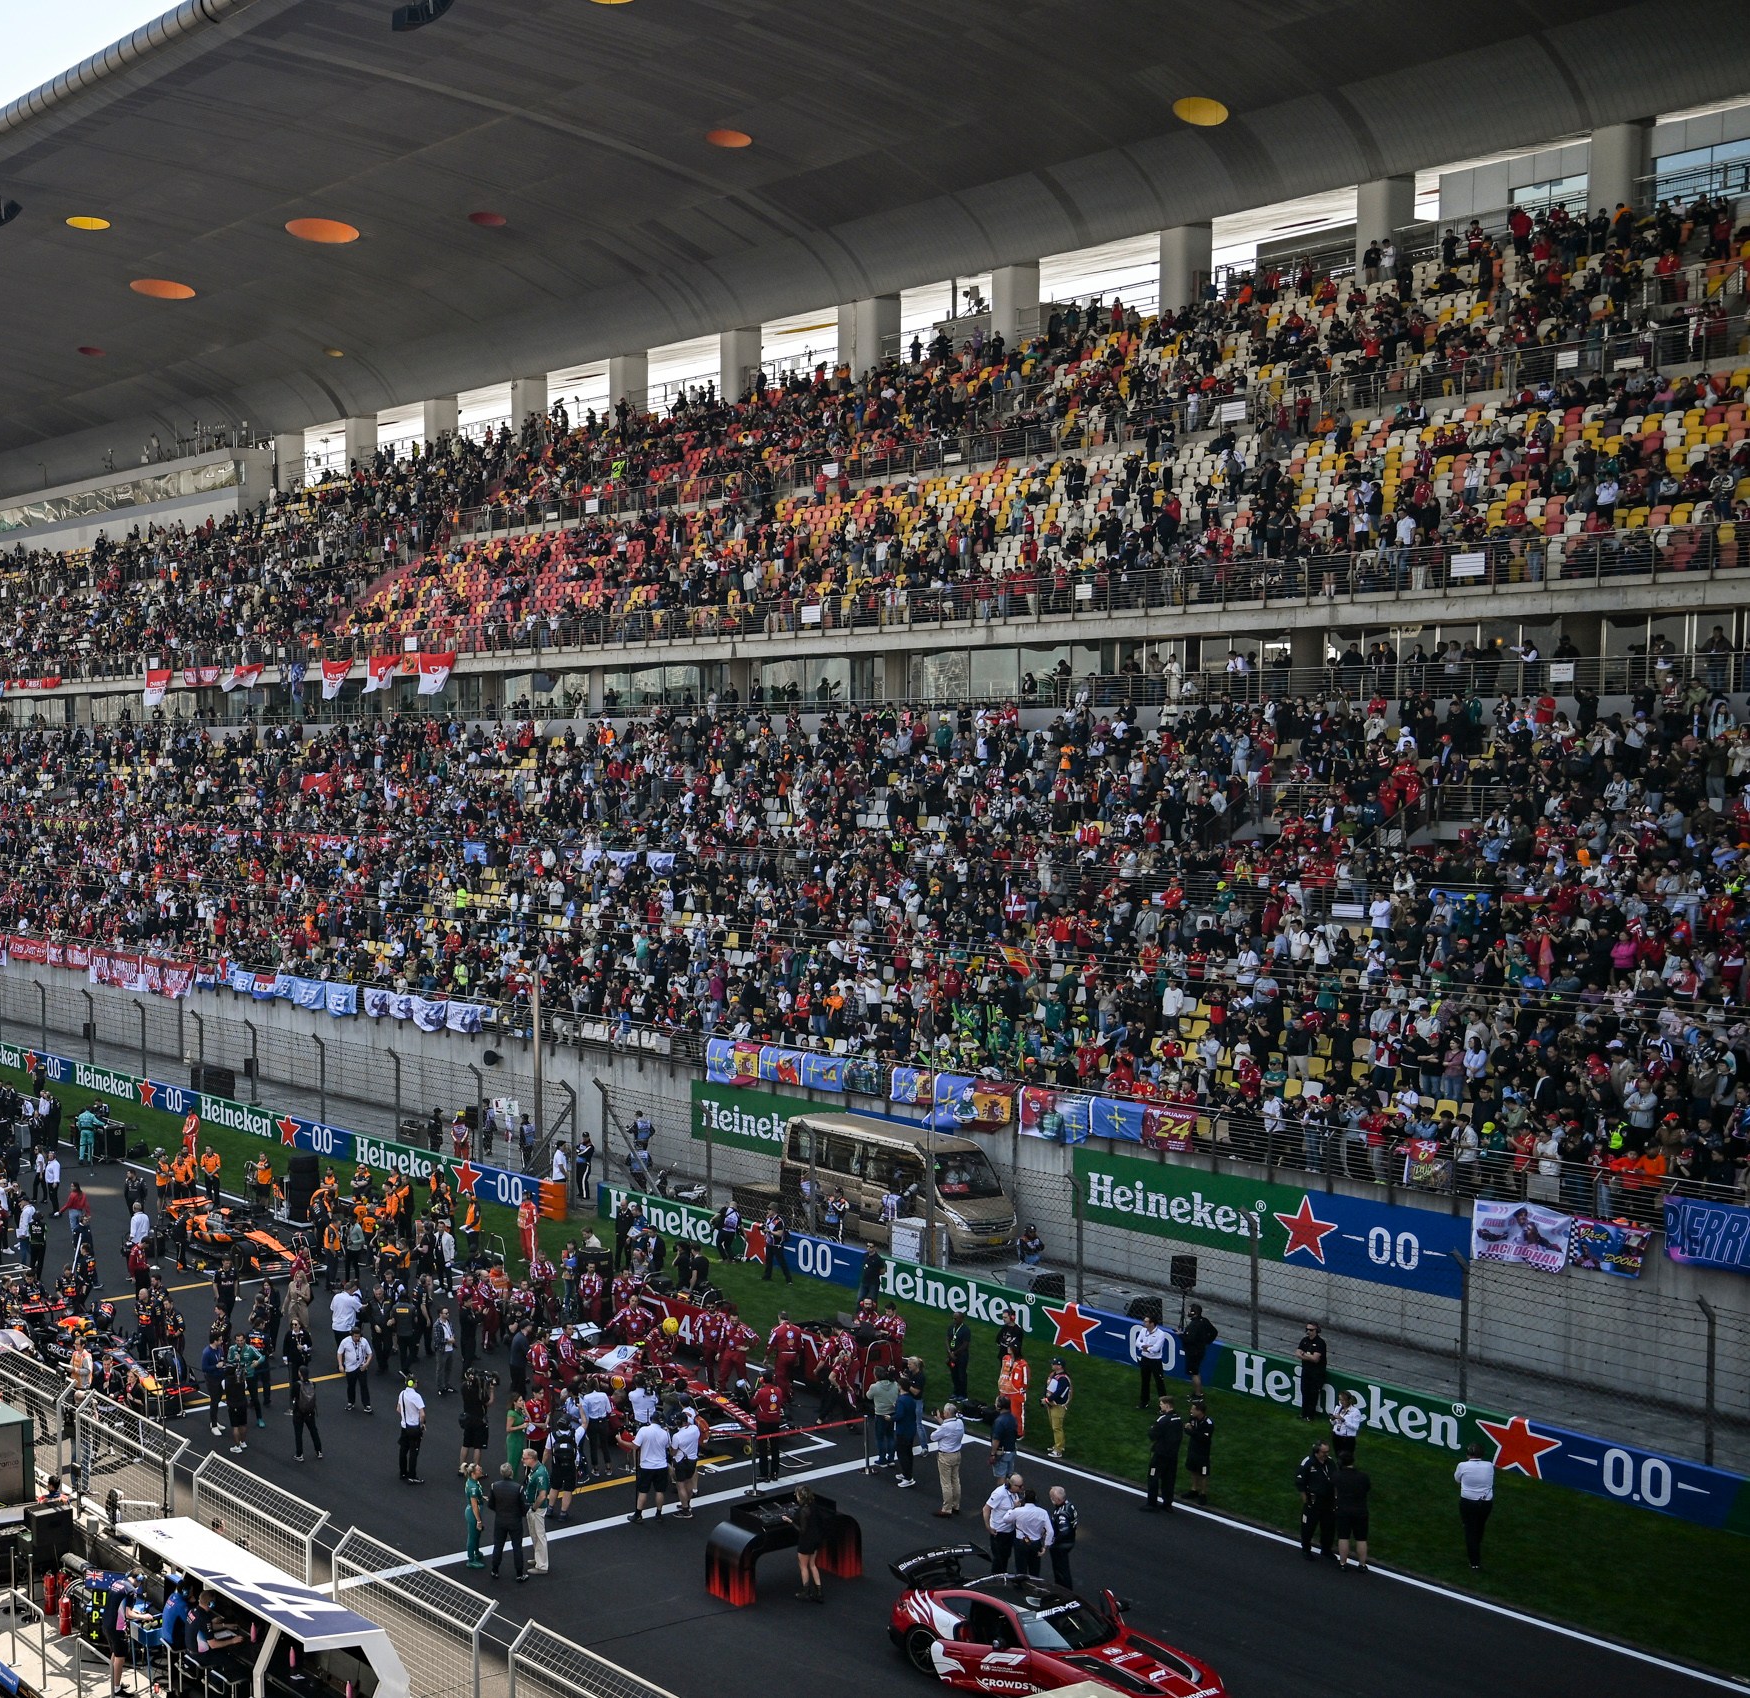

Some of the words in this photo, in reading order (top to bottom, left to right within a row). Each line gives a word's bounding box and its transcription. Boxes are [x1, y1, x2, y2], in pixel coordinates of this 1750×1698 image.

[75, 1063, 134, 1099] Heineken
[201, 1095, 272, 1138] Heineken
[311, 1125, 333, 1154] 0.0
[1155, 1117, 1192, 1140] 24
[498, 1173, 523, 1206] 0.0
[1087, 1172, 1262, 1239] Heineken
[1368, 1226, 1418, 1271] 0.0
[798, 1237, 832, 1278] 0.0
[1603, 1448, 1671, 1506] 0.0
[898, 1555, 925, 1571] Black
[927, 1548, 972, 1558] Series
